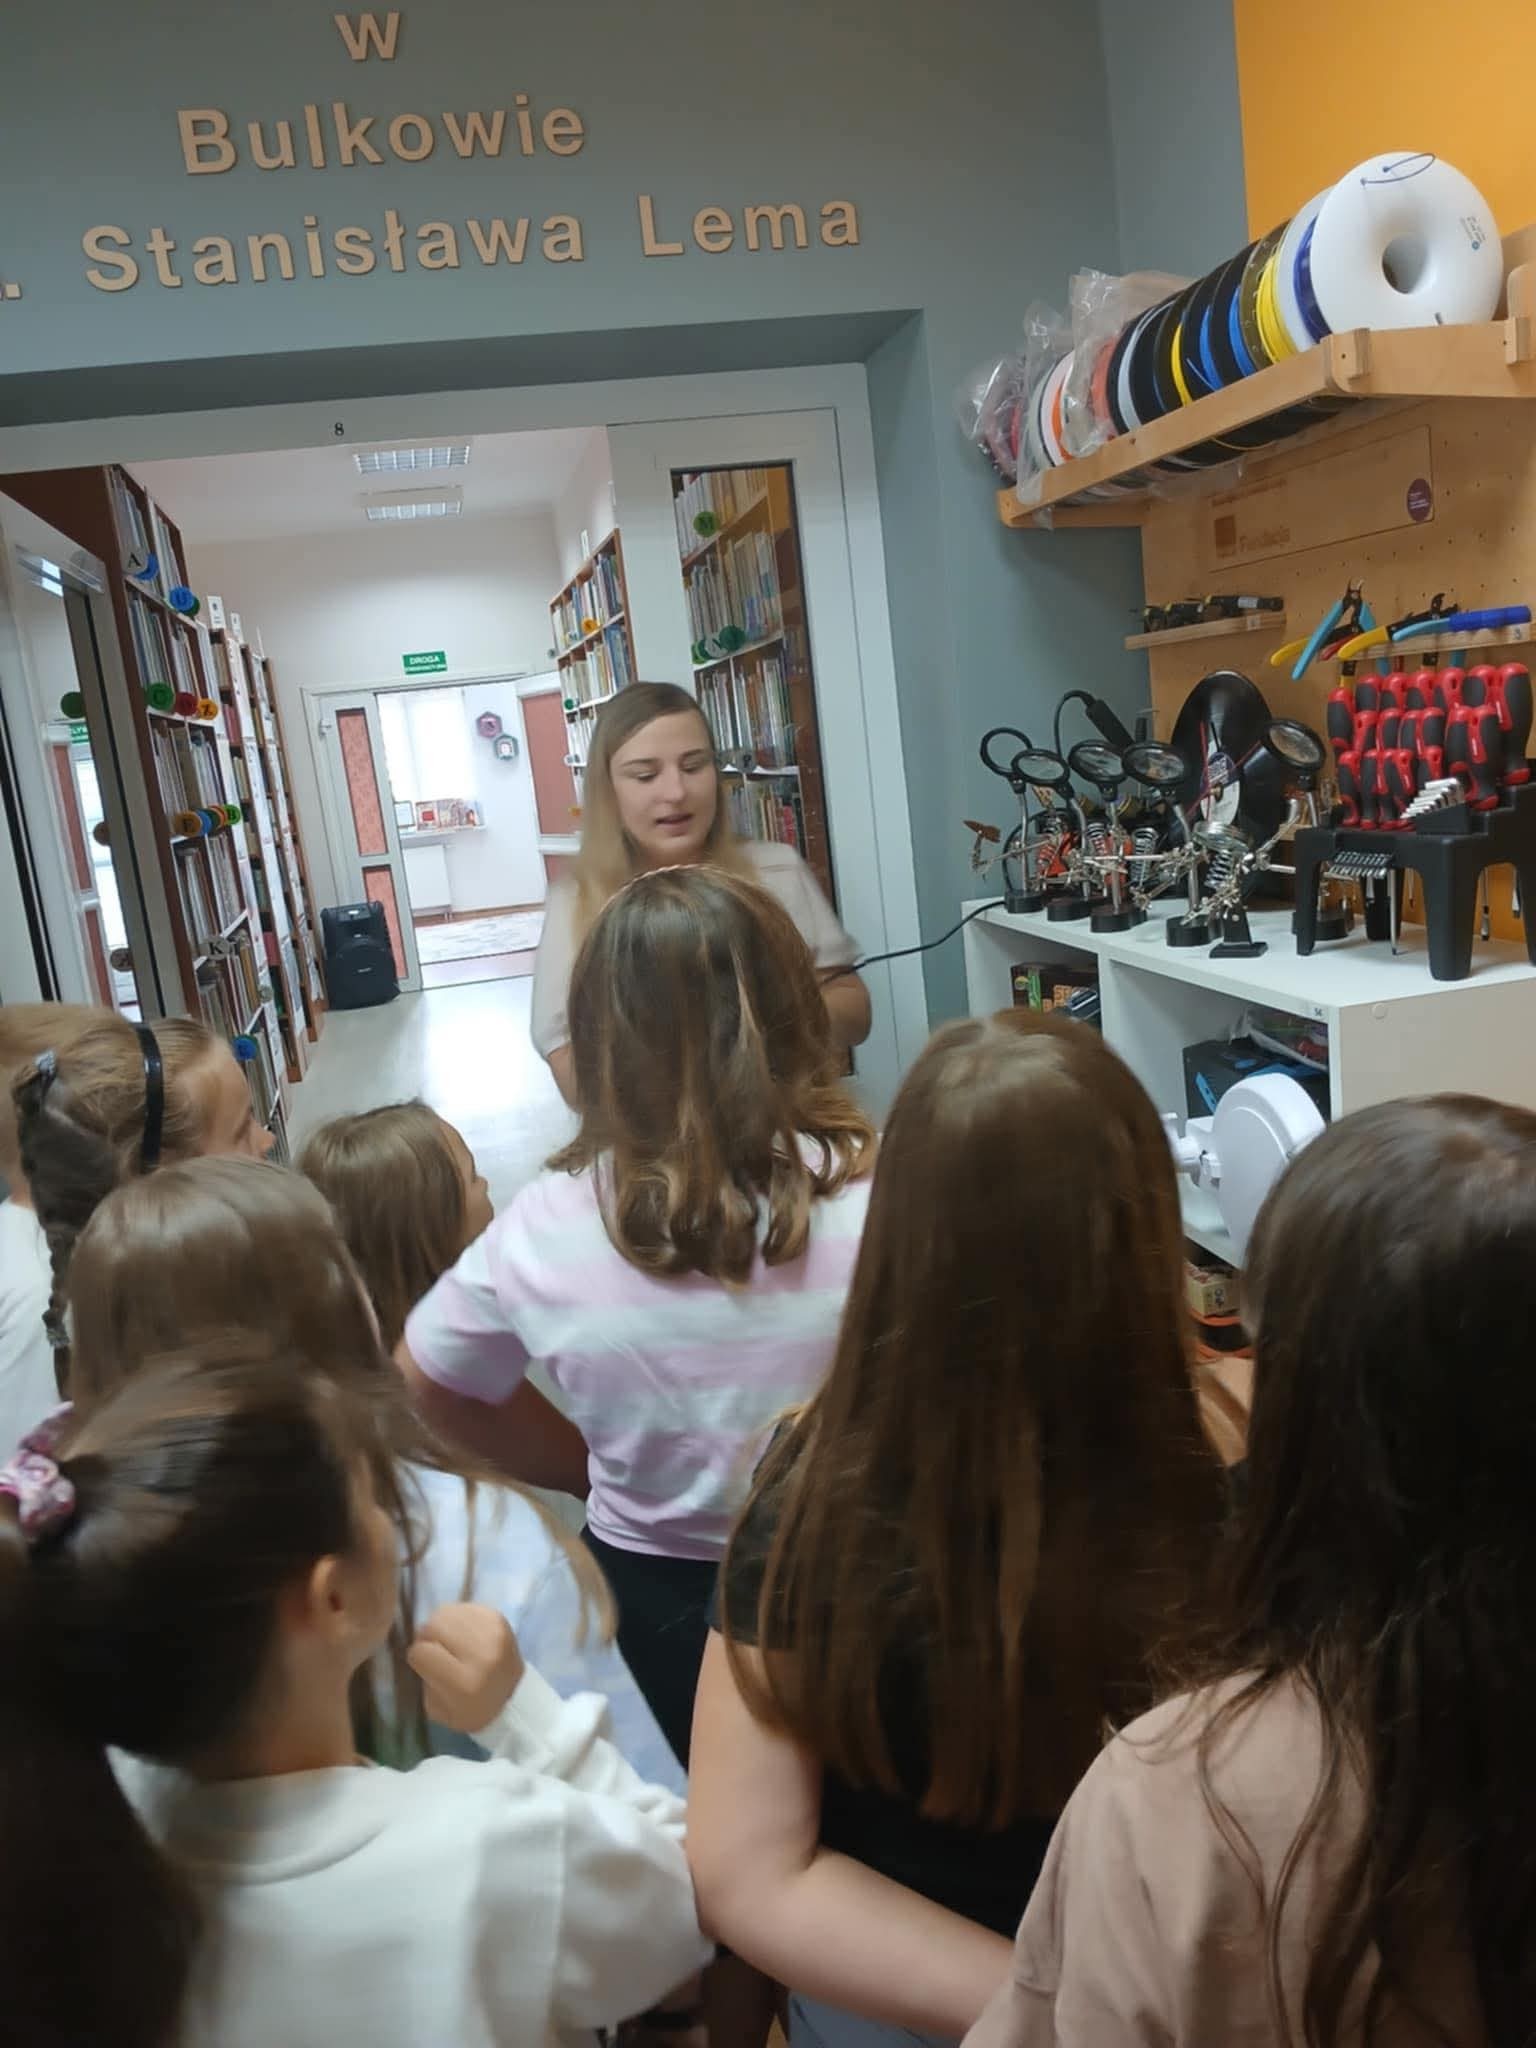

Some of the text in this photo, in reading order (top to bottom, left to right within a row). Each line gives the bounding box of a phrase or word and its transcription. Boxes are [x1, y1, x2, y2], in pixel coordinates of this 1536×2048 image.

[176, 94, 586, 176] Bulkowie
[81, 194, 861, 292] Stanisława Lema
[335, 422, 344, 436] 8
[128, 551, 141, 569] A
[409, 655, 441, 665] DROGA
[209, 941, 224, 955] K
